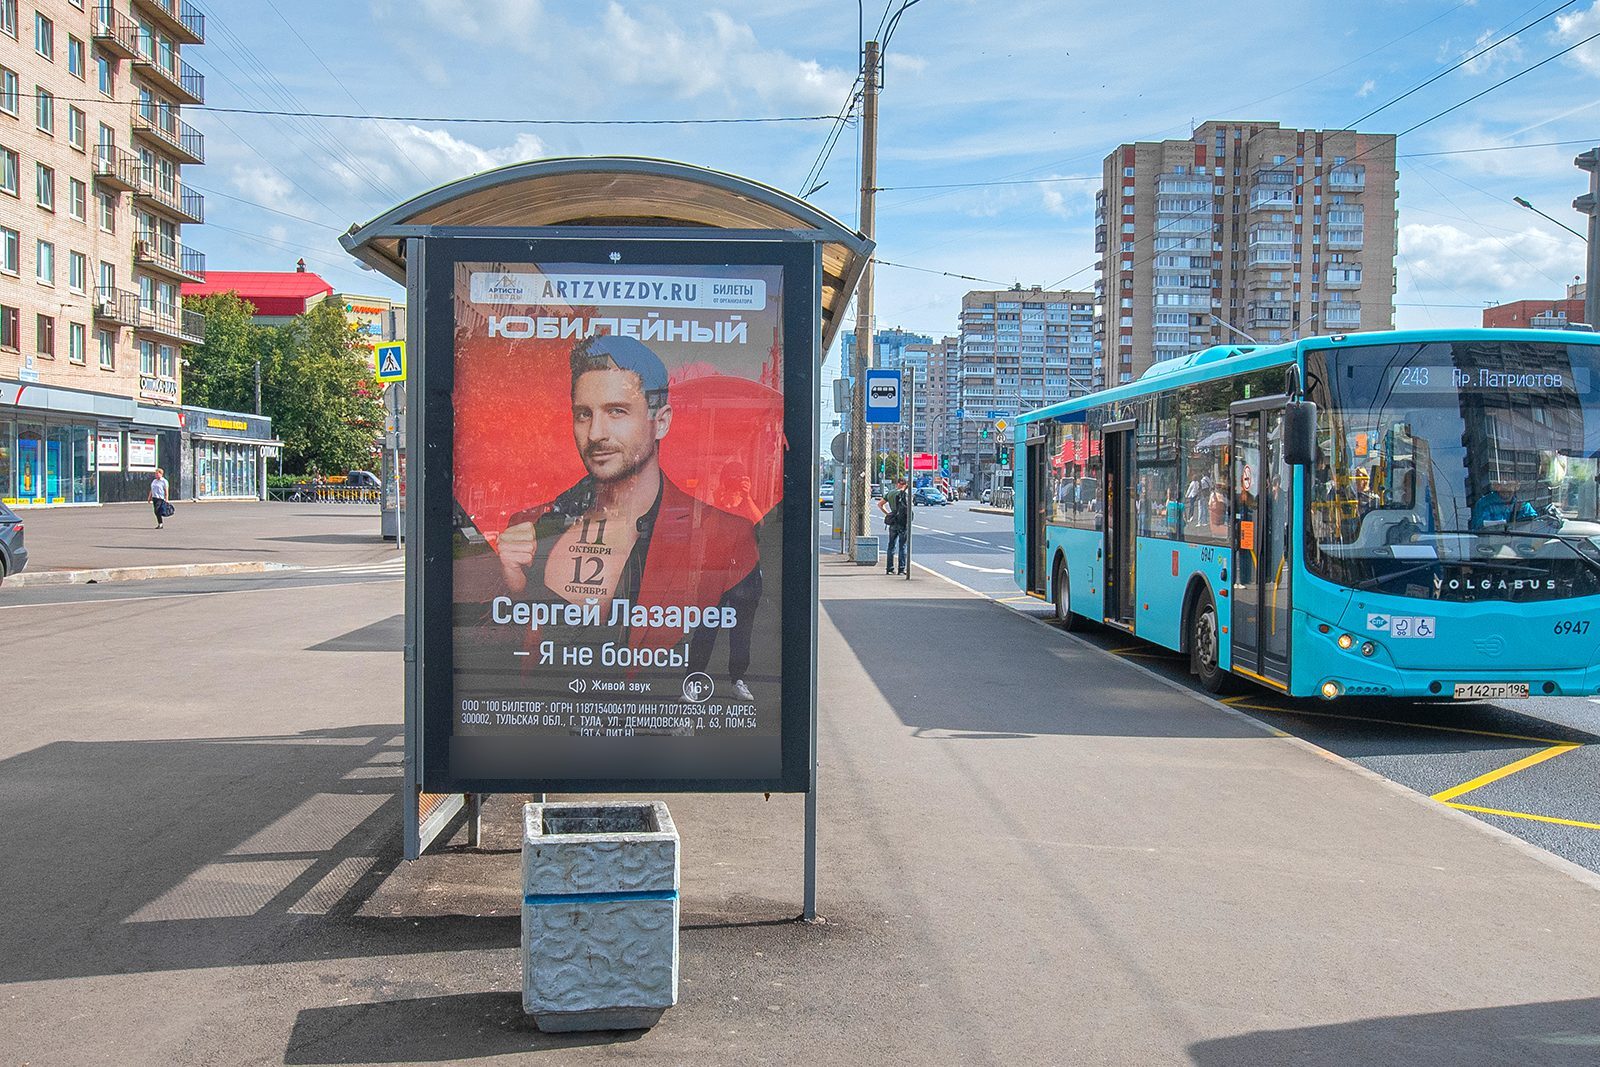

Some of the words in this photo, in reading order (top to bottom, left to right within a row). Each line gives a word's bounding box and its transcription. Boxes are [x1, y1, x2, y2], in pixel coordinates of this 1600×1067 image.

[542, 280, 697, 301] ARTZVEZDY.RU
[713, 284, 753, 295] БИЛЕТЫ
[488, 312, 747, 344] ЮБИЛЕЙНЫЙ
[1401, 367, 1429, 386] 243
[576, 518, 607, 545] 11
[569, 545, 612, 554] ОКТЯБРЯ
[1200, 547, 1215, 562] 6947
[569, 556, 605, 585] 12
[564, 585, 608, 595] ОКТЯБРЯ
[1434, 579, 1556, 590] VOLGABUS
[492, 596, 600, 630] Сергей
[608, 598, 738, 633] Лазарев
[1554, 620, 1590, 635] 6947
[539, 641, 554, 665] Я
[563, 647, 593, 665] не
[601, 642, 690, 667] боюсь!
[592, 679, 626, 691] Живой
[629, 682, 651, 691] звук
[688, 681, 710, 694] 16+
[1508, 684, 1526, 694] 198
[461, 700, 479, 711] ООО
[550, 702, 573, 713] ОГРН
[576, 703, 637, 714] 1187154006170
[638, 704, 657, 715] ИНН
[660, 704, 706, 716] 7107125534
[708, 705, 724, 716] ЮР.
[726, 705, 757, 717] АДРЕС:
[461, 713, 492, 725] 300002,
[496, 713, 539, 725] ТУЛЬСКАЯ
[542, 715, 566, 727] ОБЛ.,
[569, 716, 577, 726] Г.
[580, 716, 604, 727] ТУЛА,
[607, 716, 621, 727] УЛ.
[625, 717, 693, 729] ДЕМИДОВСКАЯ,
[696, 718, 706, 729] Д.
[709, 718, 722, 729] 63,
[725, 718, 757, 729] ПОМ.54
